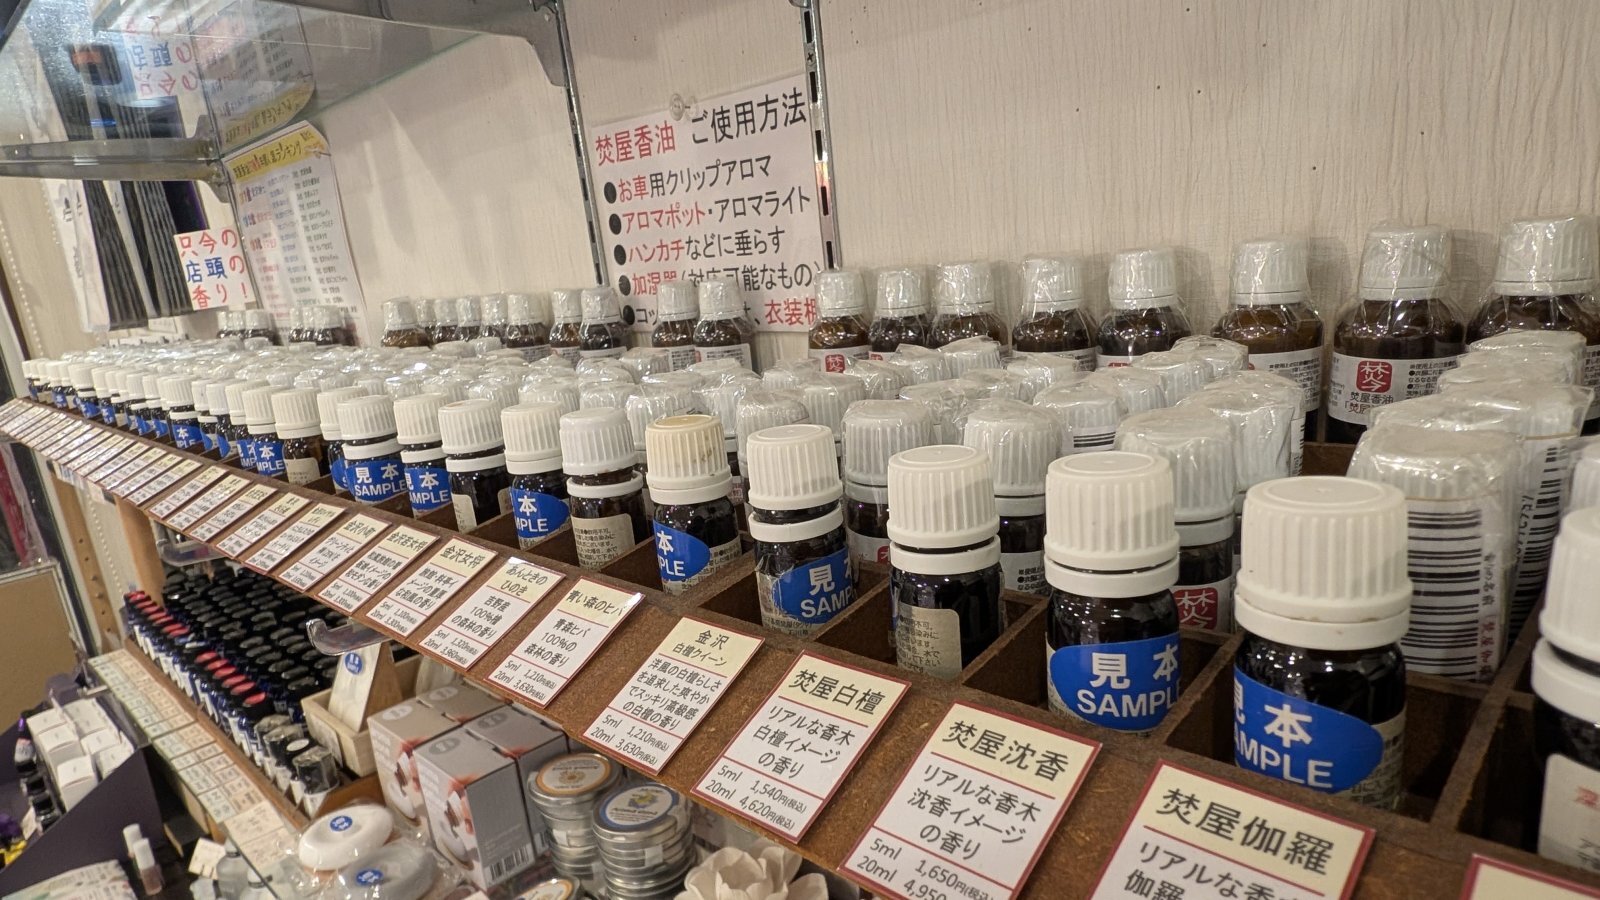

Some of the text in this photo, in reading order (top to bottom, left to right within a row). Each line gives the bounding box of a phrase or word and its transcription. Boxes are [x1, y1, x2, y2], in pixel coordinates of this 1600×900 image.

[595, 87, 807, 166] 焚屋香油 ご使用方法
[618, 155, 771, 202] お車用クリップアロマ
[622, 185, 811, 234] アロマポット・アロマライト
[179, 229, 237, 257] 只今の
[629, 226, 786, 262] ハンカチなどに垂らす
[186, 255, 245, 283] 店頭の
[440, 544, 487, 570] 金沢女将
[499, 578, 529, 597] ひのき
[505, 564, 549, 587] あんときの
[483, 594, 512, 614] 吉野産
[565, 590, 627, 618] 青い森のヒバ
[434, 628, 451, 641] 5ml
[450, 614, 497, 641] の森林の香り
[540, 631, 578, 652] 100%の
[552, 618, 592, 639] 青森ヒバ
[423, 637, 444, 653] 20ml
[523, 642, 571, 669] 森林の香り
[672, 642, 728, 667] 白檀クイーン
[493, 670, 515, 685] 20ml
[504, 659, 523, 672] 5ml
[647, 657, 723, 693] 洋風の白檀らしさ
[628, 684, 700, 722] でスッキリ高級感
[635, 670, 711, 706] を追求した爽やか
[788, 668, 887, 716] 焚屋白檀
[622, 700, 683, 732] の白檀の香り
[767, 705, 856, 747] リアルな香木
[590, 726, 658, 767] 20ml 3,630円(税込)
[602, 714, 671, 753] 5ml 1,210円(税込)
[753, 724, 842, 765] 白檀イメージ
[758, 752, 805, 779] の香り
[942, 720, 1069, 782] 焚屋沈香
[704, 779, 796, 831] 20ml 4,620円(税込)
[717, 765, 808, 814] 5ml 1,540円(税込)
[923, 764, 1042, 824] リアルな香木
[907, 787, 1026, 845] 沈香イメージ
[1155, 786, 1336, 876] 焚屋伽羅
[869, 838, 903, 861] 5ml
[919, 823, 982, 861] の香り
[856, 855, 898, 883] 20ml
[1139, 841, 1297, 900] リアルな香
